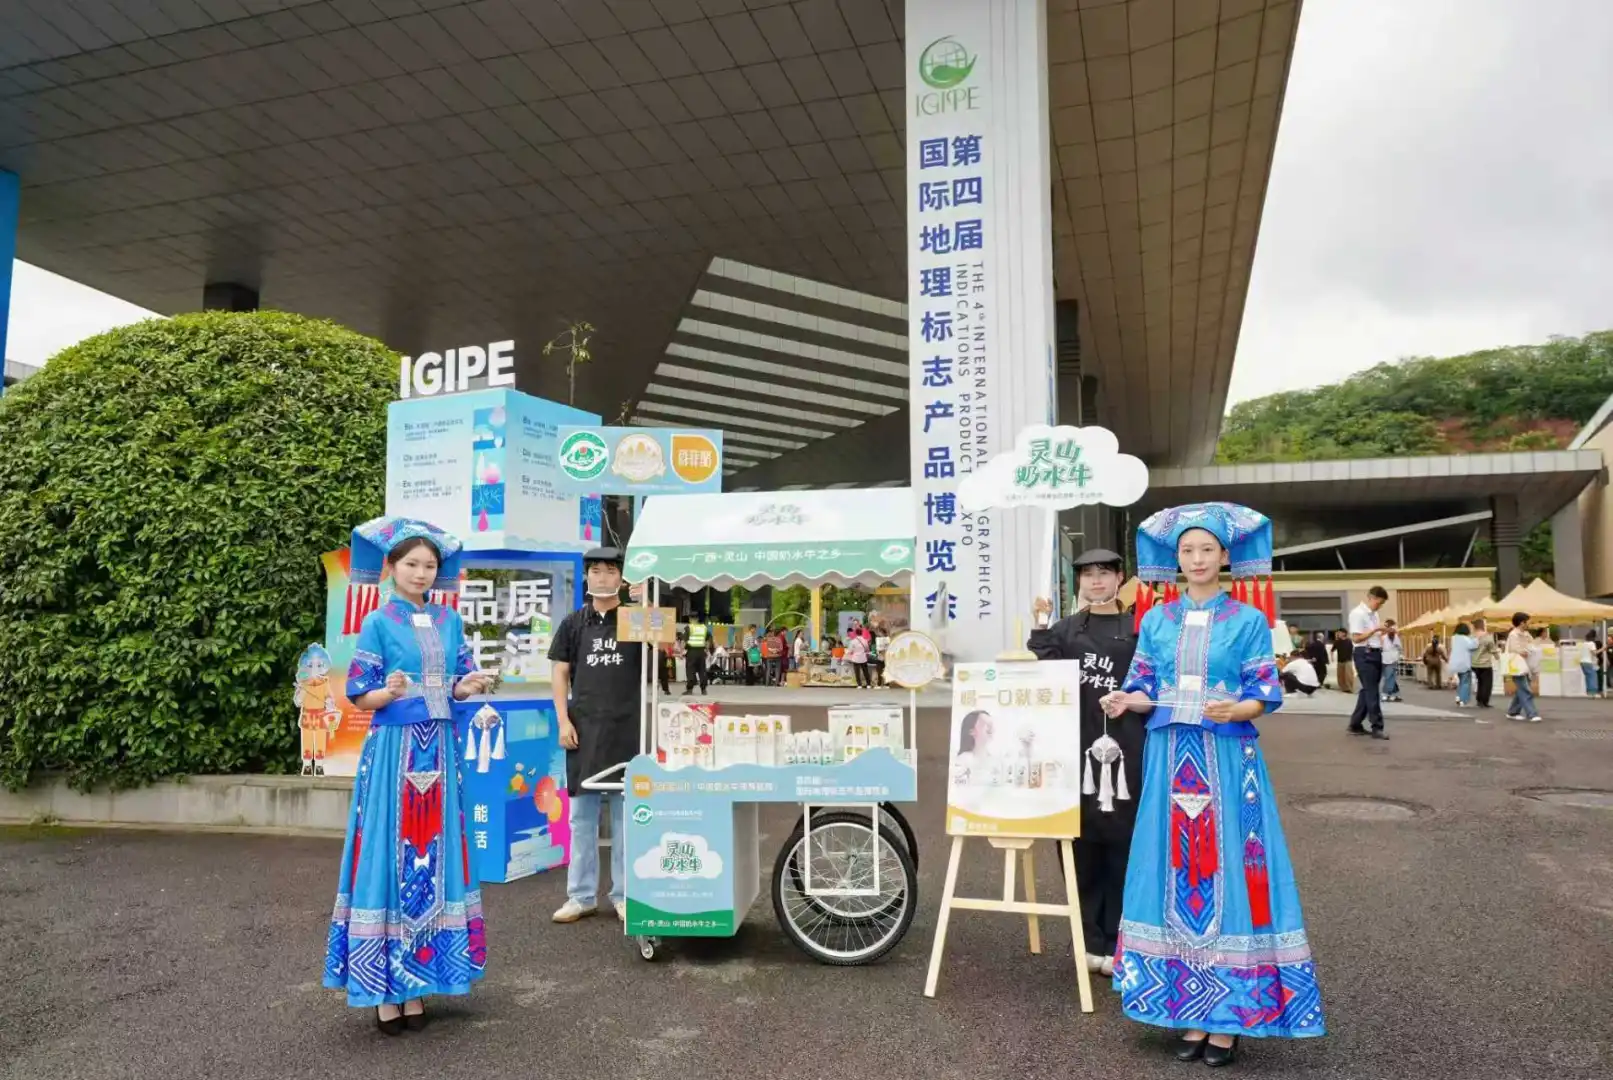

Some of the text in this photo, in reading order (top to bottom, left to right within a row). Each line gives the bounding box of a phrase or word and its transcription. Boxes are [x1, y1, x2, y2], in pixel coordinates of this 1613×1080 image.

[951, 135, 983, 251] 第四届
[972, 261, 984, 293] THE
[400, 340, 515, 399] IGIPE
[956, 263, 973, 546] INDICATIONS PRODUCT XPO
[974, 326, 988, 468] INTERNATIONAL
[1029, 438, 1084, 464] 灵山
[1014, 463, 1094, 488] 奶水牛
[976, 504, 991, 620] GRAPHICAL
[457, 578, 552, 625] 品质
[592, 637, 617, 652] 灵山
[586, 652, 624, 667] 奶水牛
[1083, 652, 1114, 673] 灵山
[666, 840, 695, 858] 灵山
[660, 856, 703, 872] 奶水牛
